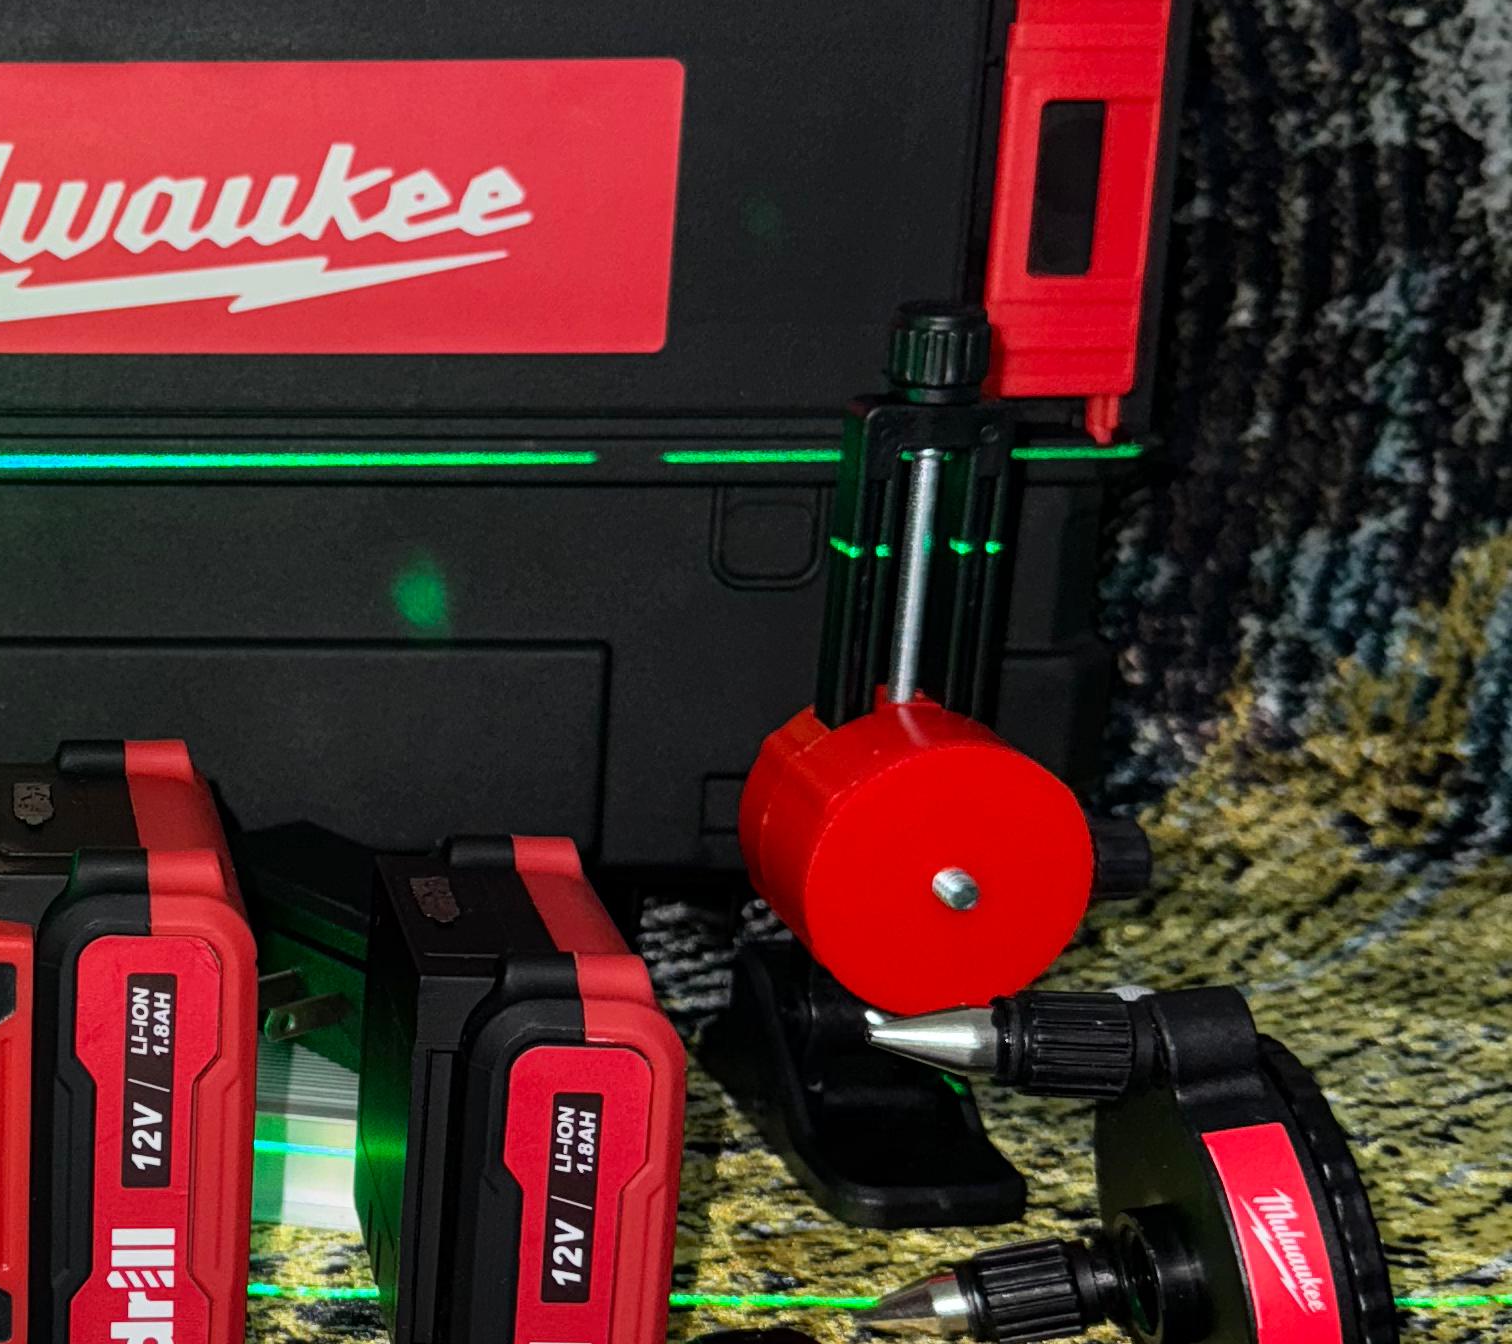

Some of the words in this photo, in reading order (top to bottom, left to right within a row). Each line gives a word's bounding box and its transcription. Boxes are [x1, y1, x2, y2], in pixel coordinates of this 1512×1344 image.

[130, 986, 150, 1055] LI-ION
[152, 991, 171, 1056] 1.8AH
[131, 1101, 163, 1170] 12V
[554, 1105, 575, 1173] LI-ION
[576, 1111, 596, 1174] 1.8AH
[551, 1218, 584, 1286] 12V
[1252, 1188, 1328, 1313] Milwaukee
